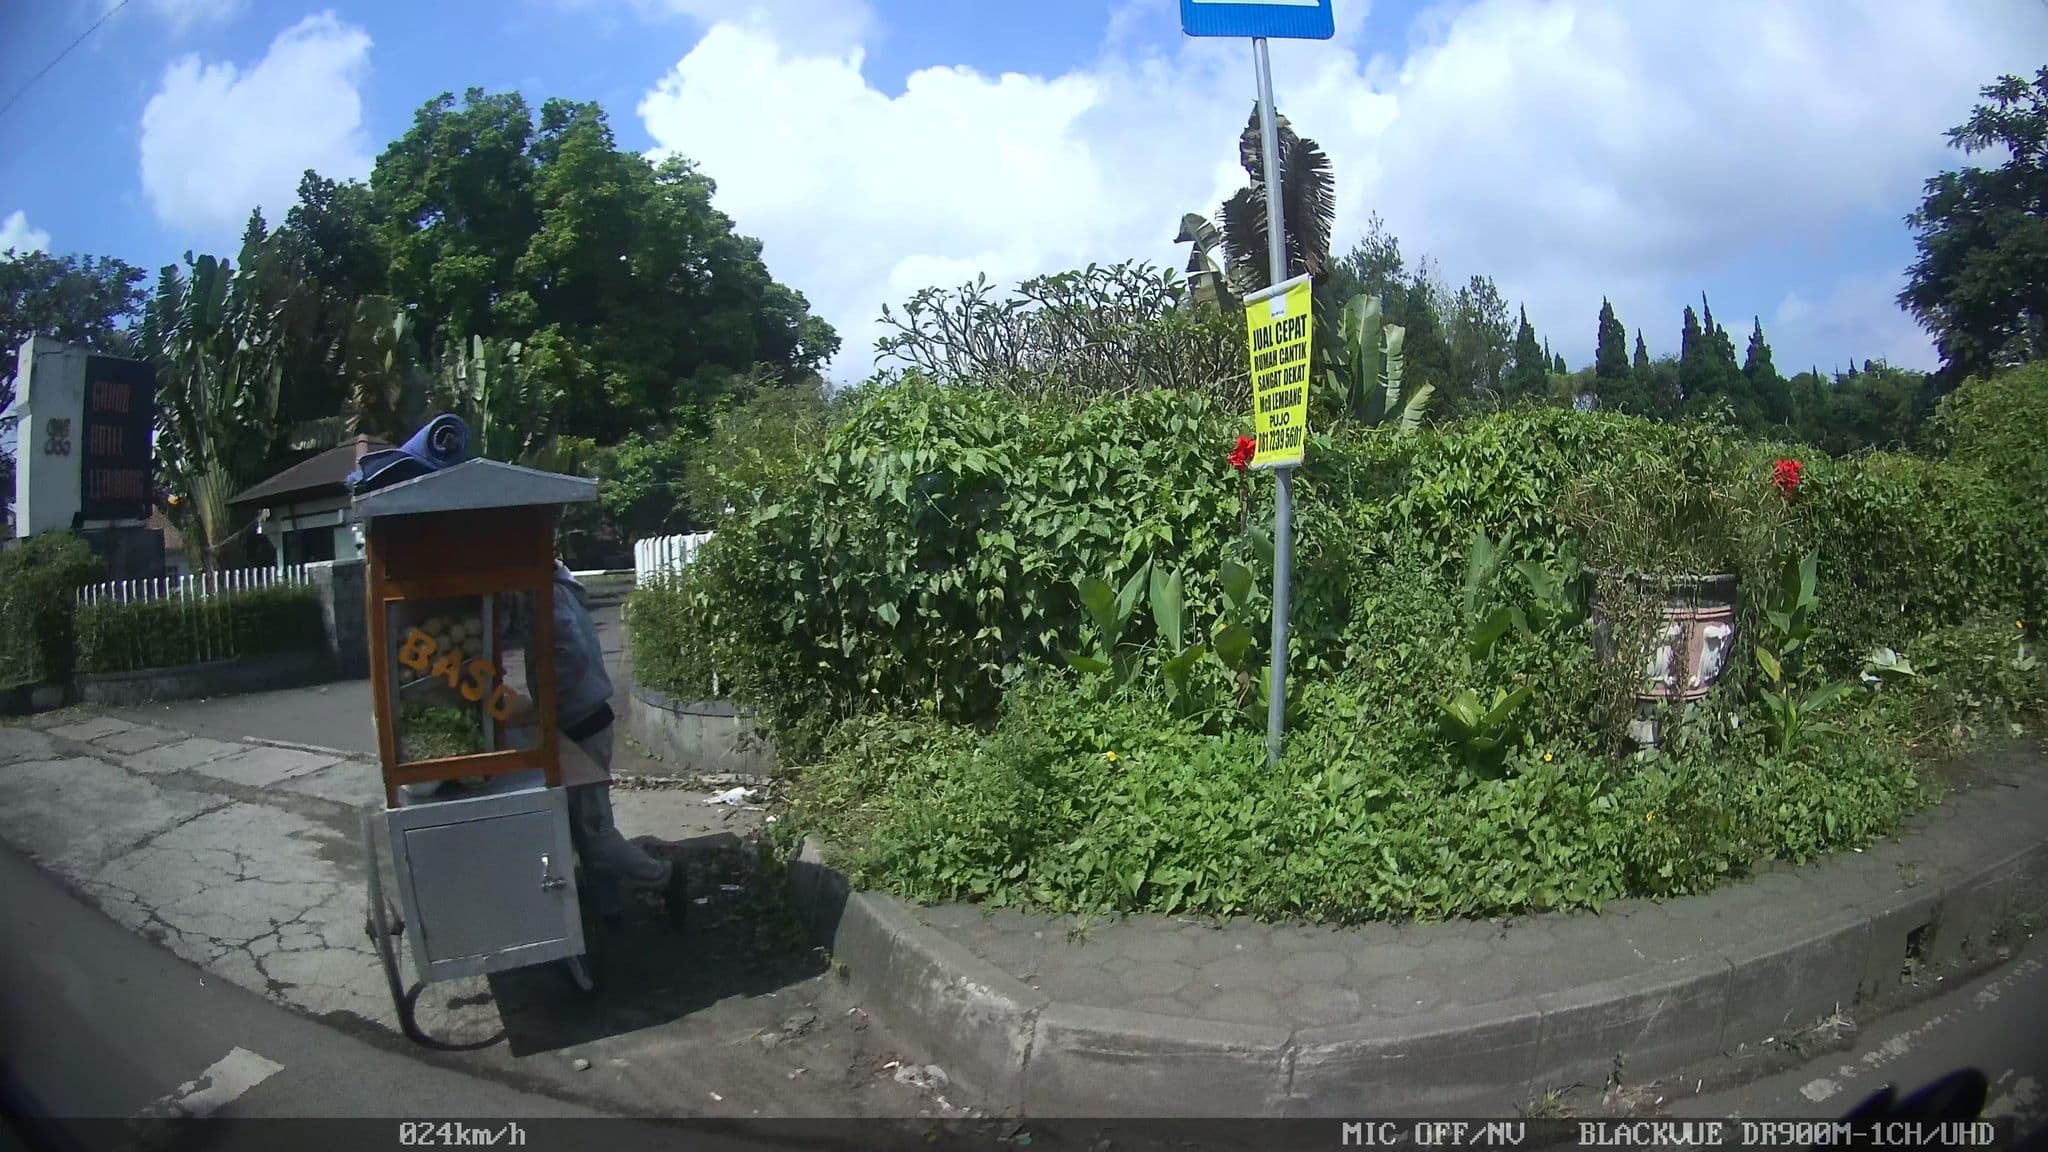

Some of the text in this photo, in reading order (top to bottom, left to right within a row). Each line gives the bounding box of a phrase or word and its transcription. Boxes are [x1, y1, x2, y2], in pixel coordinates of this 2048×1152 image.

[1253, 314, 1307, 352] JUAL CEPAT
[1254, 342, 1306, 371] RUMAH CANTIK
[1258, 364, 1305, 392] SANGAT DEKAT
[1273, 387, 1302, 410] LEMBANG
[1270, 412, 1289, 428] PUJO
[90, 424, 125, 456] HOTEL
[399, 627, 518, 721] BASO
